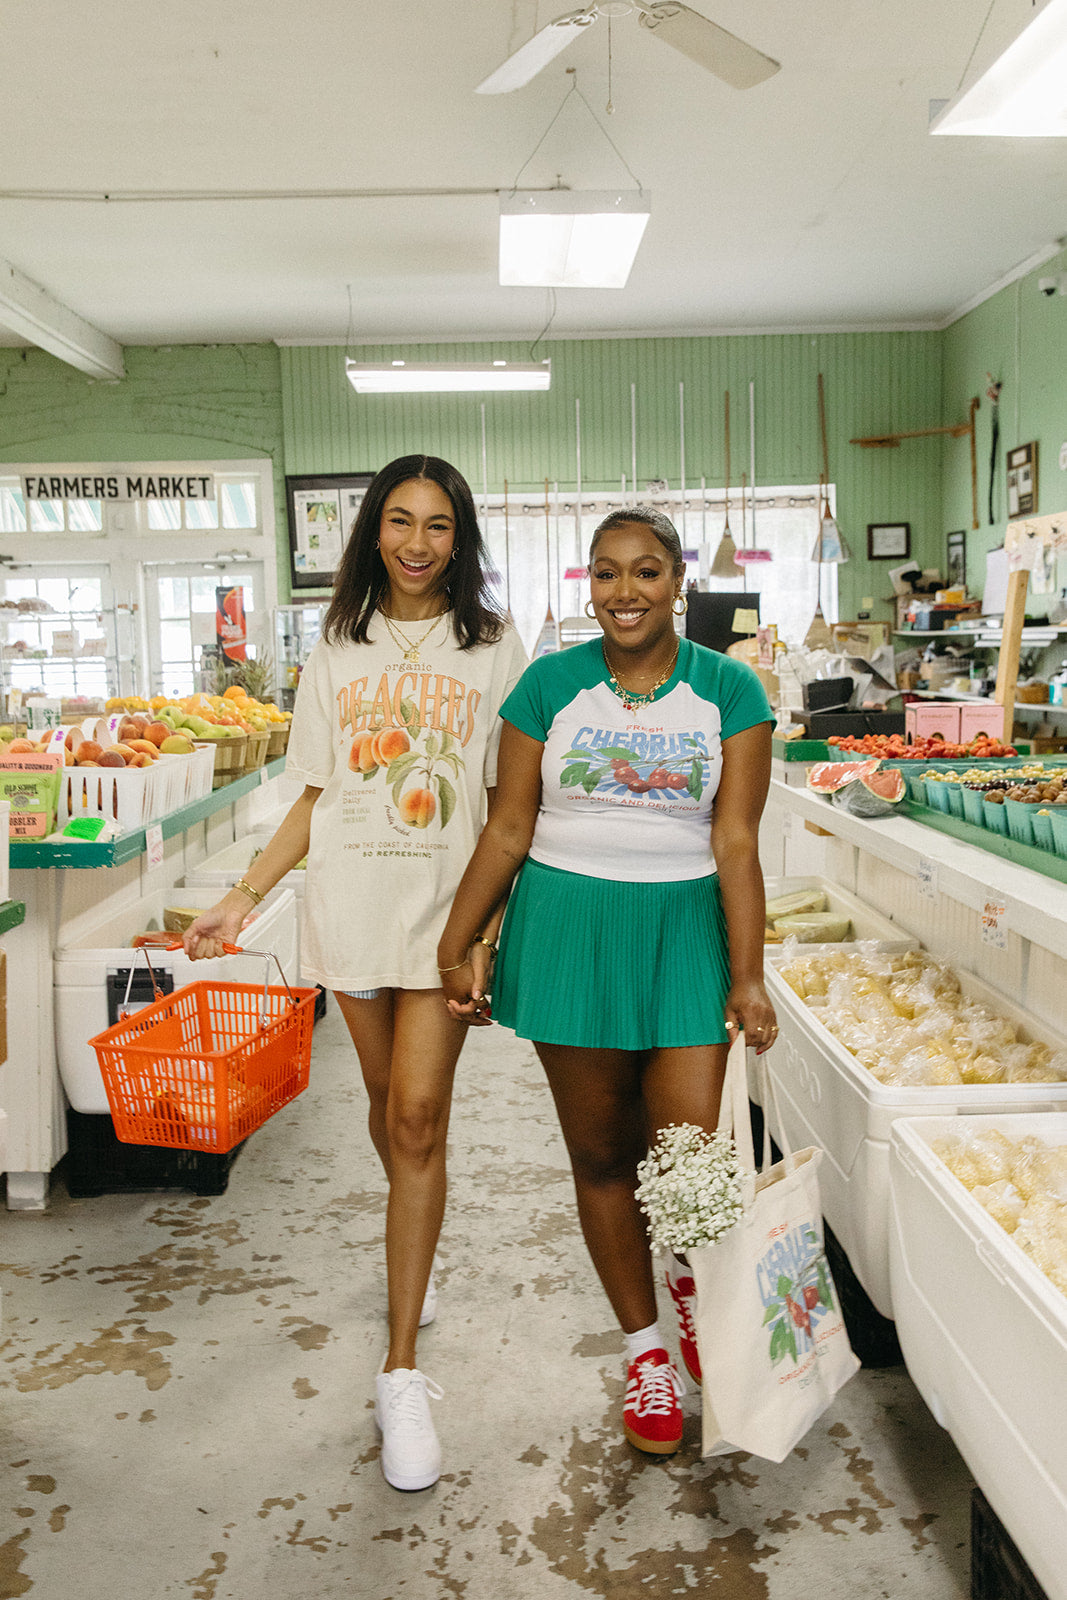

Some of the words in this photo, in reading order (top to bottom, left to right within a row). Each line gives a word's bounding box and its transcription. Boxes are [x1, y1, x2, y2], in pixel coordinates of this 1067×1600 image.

[25, 477, 119, 498] FARMERS
[126, 477, 210, 498] MARKET
[385, 662, 433, 673] organic
[336, 672, 482, 748] PEACHES
[626, 724, 664, 733] FRESH
[571, 727, 709, 758] CHERRIES
[566, 795, 616, 804] ORGANIC
[620, 799, 644, 808] AND
[343, 842, 360, 850] FROM
[361, 841, 375, 849] THE
[378, 841, 400, 849] COAST
[403, 841, 413, 849] OF
